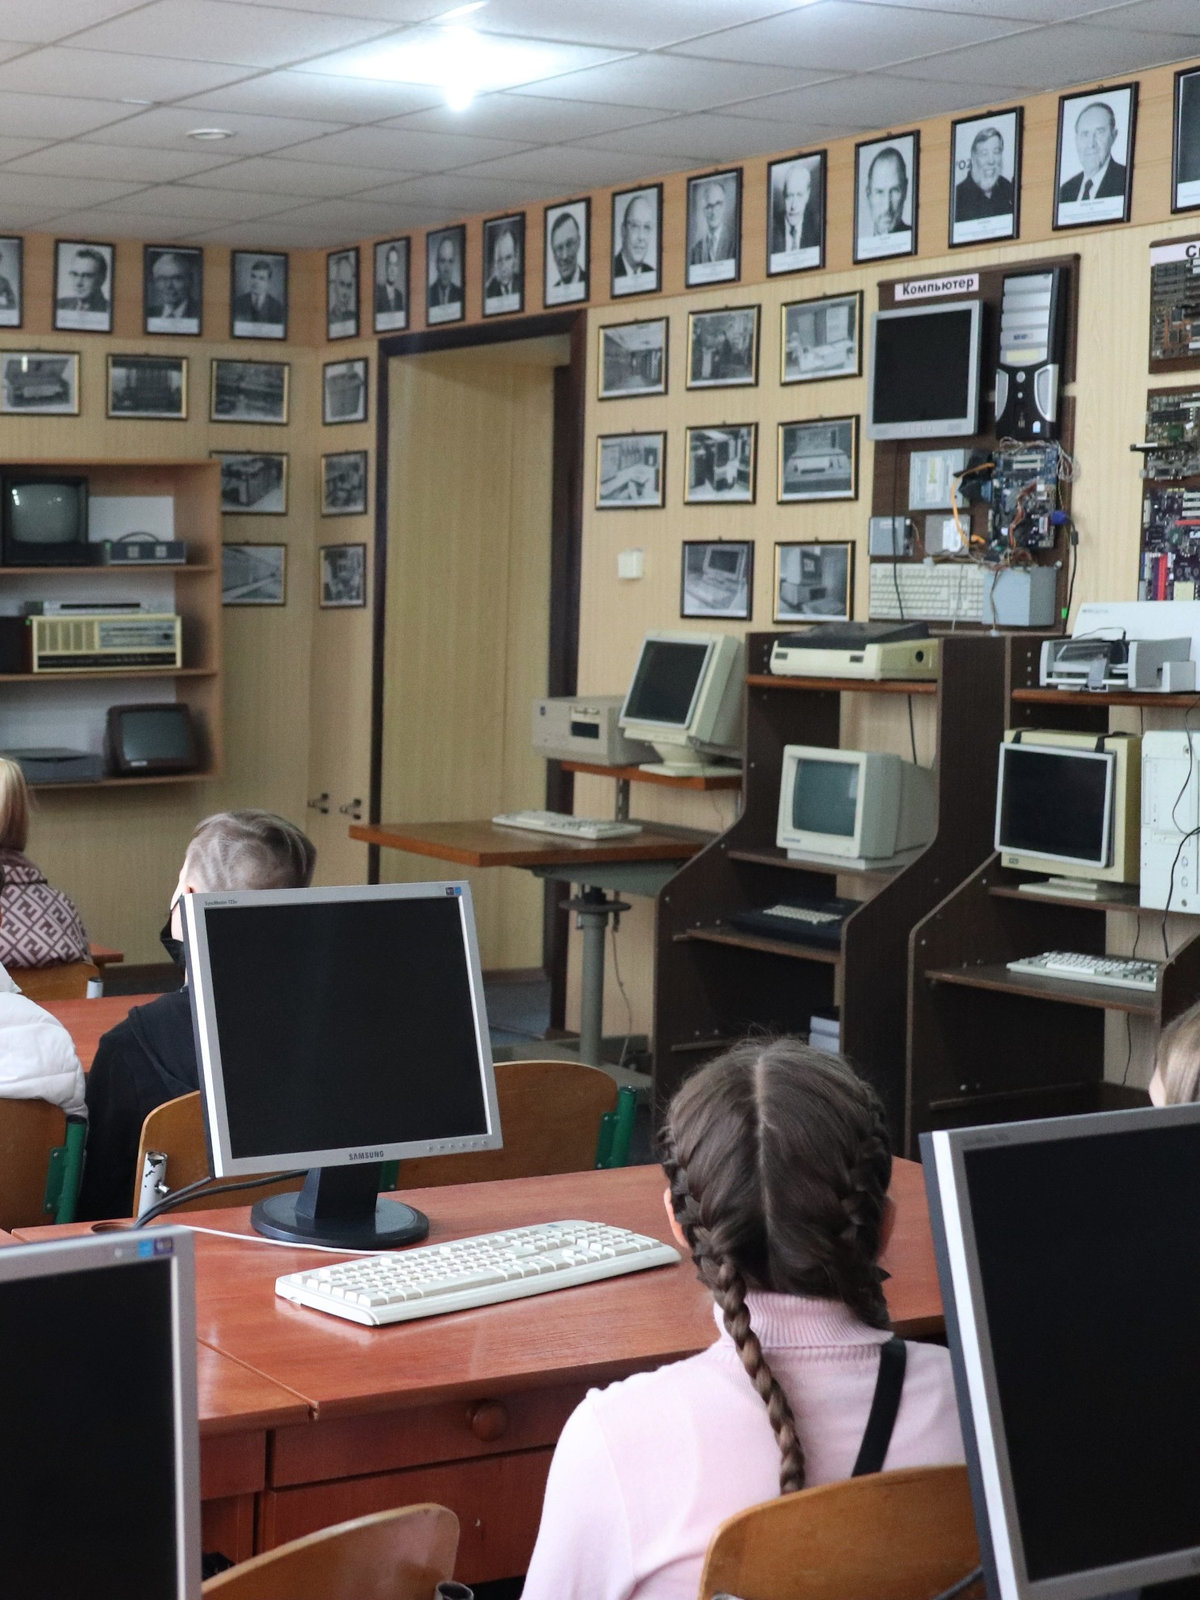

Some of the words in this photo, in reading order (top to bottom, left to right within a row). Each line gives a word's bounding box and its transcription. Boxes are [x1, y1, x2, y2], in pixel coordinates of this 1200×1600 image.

[1185, 244, 1200, 258] С
[902, 277, 974, 296] Компьютер
[349, 1150, 384, 1160] SAMSUNG
